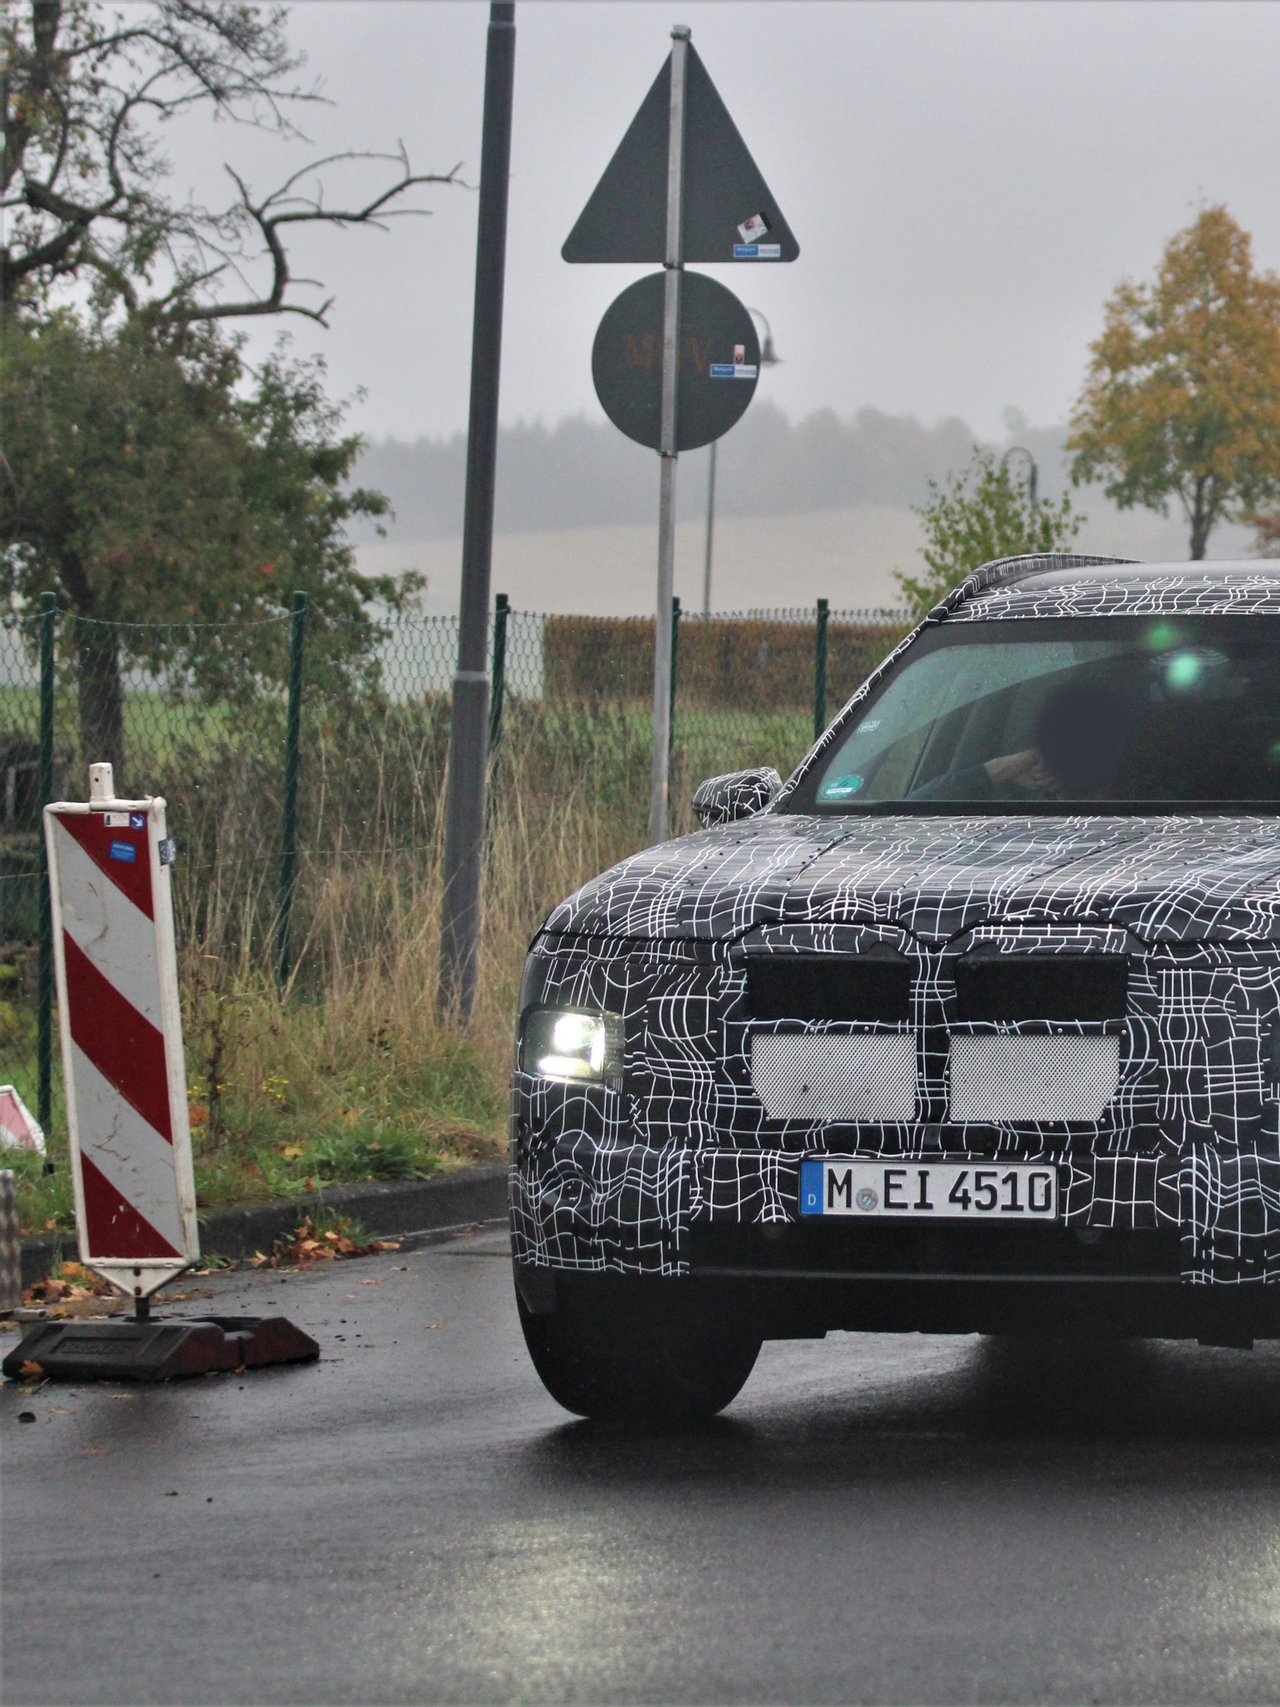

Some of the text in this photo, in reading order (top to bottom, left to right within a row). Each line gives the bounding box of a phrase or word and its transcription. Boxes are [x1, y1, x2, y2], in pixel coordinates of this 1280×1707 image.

[807, 1193, 817, 1206] D
[827, 1168, 1052, 1212] M EI 4510
